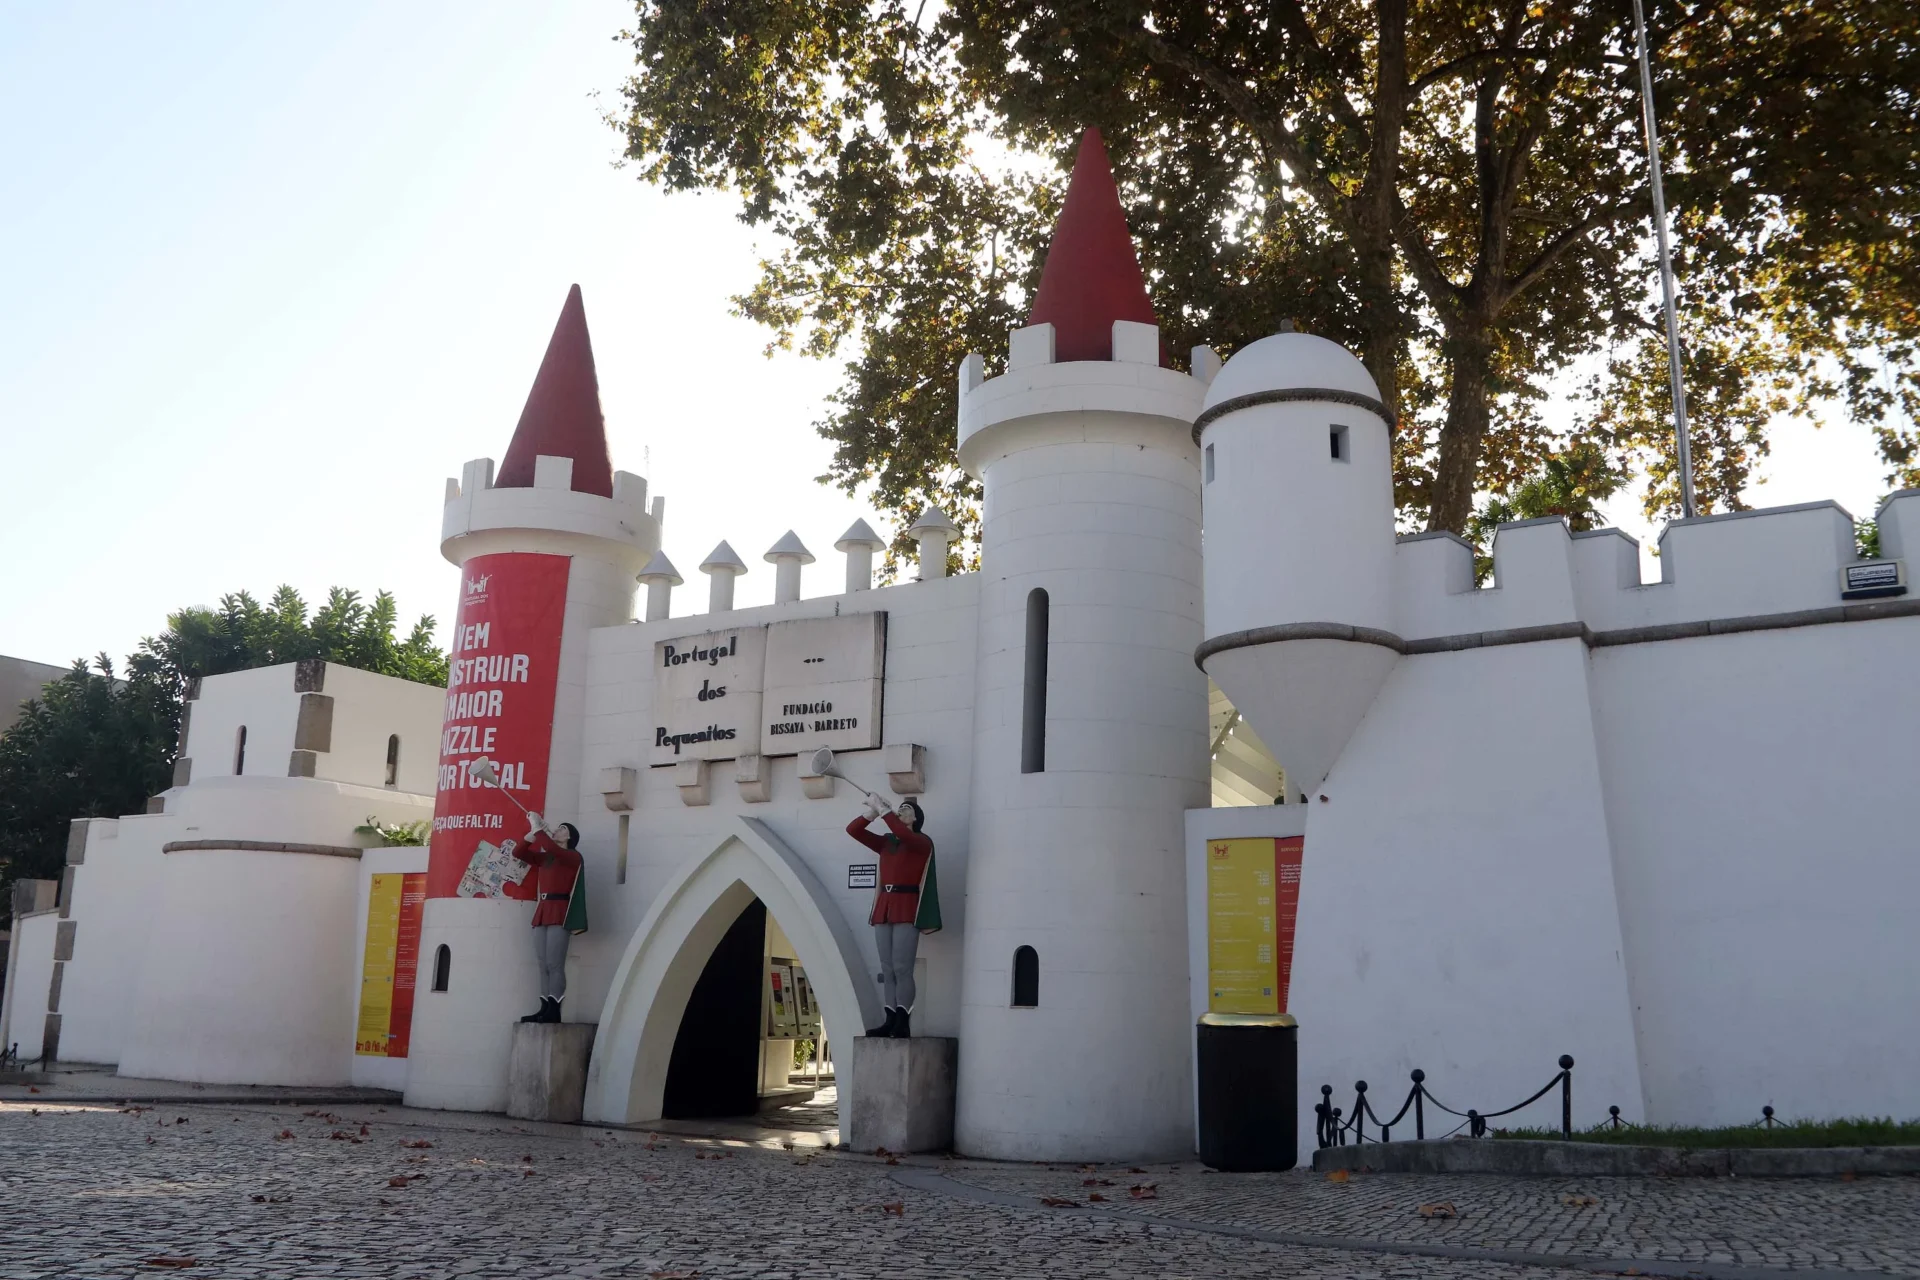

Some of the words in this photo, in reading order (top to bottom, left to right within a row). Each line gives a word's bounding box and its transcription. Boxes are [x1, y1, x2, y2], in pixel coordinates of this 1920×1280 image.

[1851, 569, 1893, 577] GRUPEME
[457, 622, 490, 652] VEM
[663, 636, 736, 667] Portugal
[449, 654, 529, 689] NSTRUIR
[447, 690, 504, 721] MAIOR
[698, 680, 726, 701] dos
[783, 700, 833, 716] FUNDAÇÃO
[441, 726, 497, 756] UZZLE
[655, 724, 736, 754] Pequenitos
[770, 721, 805, 735] BISSAYA
[814, 717, 858, 732] BARRETO
[447, 815, 464, 830] QUE
[464, 813, 503, 829] FALTA!
